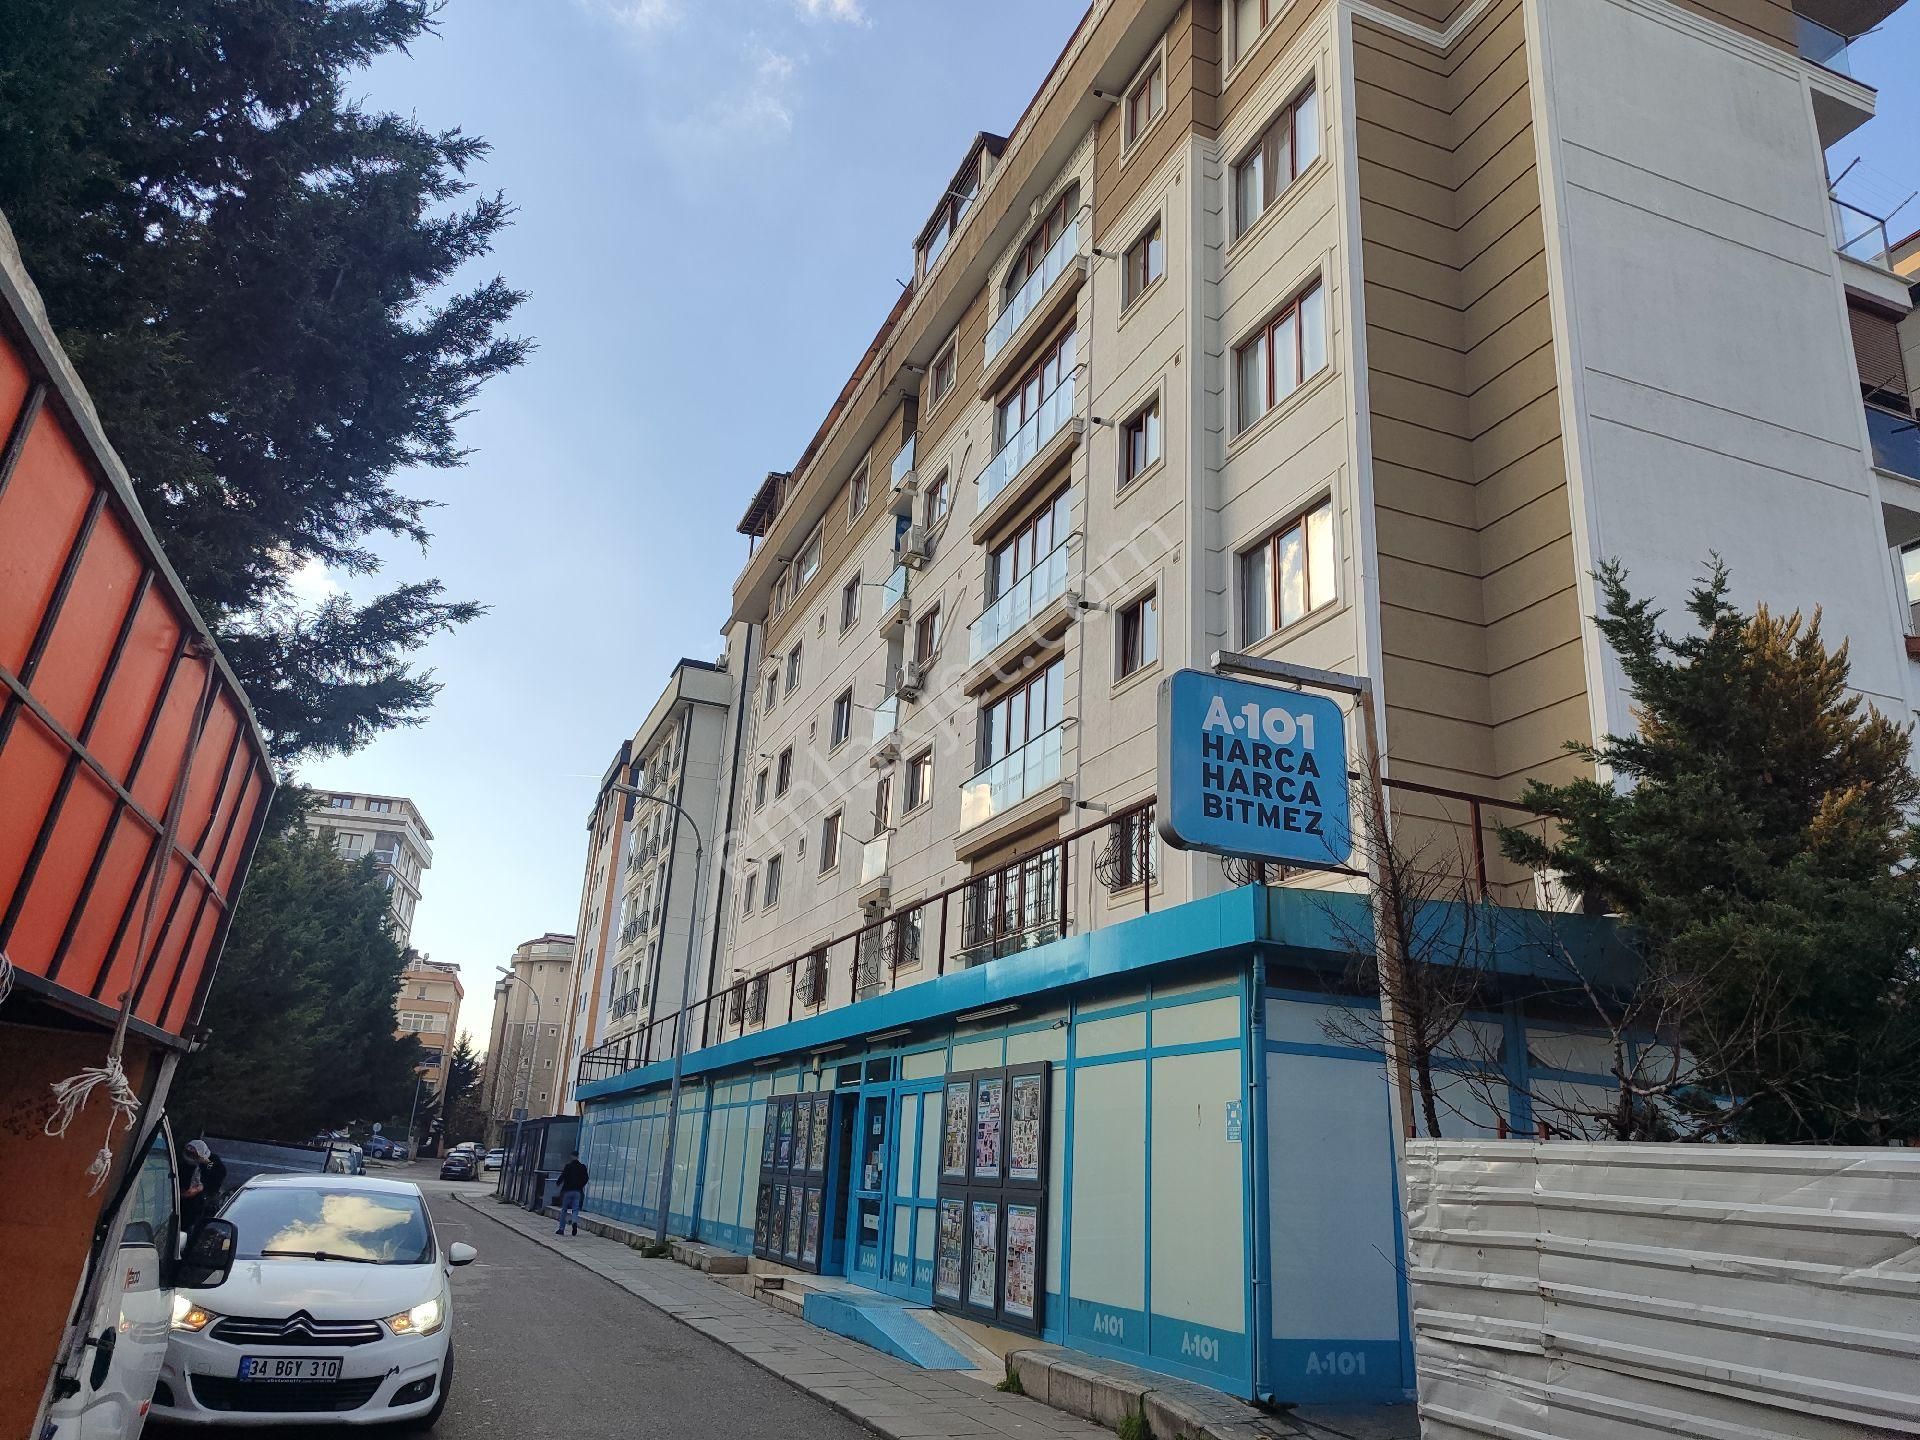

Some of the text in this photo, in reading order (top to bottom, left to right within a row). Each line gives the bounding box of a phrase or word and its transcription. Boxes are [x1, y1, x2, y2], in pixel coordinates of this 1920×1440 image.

[1202, 732, 1321, 778] HARCA
[1202, 762, 1322, 807] HARCA
[249, 1360, 268, 1376] 34
[275, 1360, 303, 1376] BGY
[310, 1361, 337, 1377] 310
